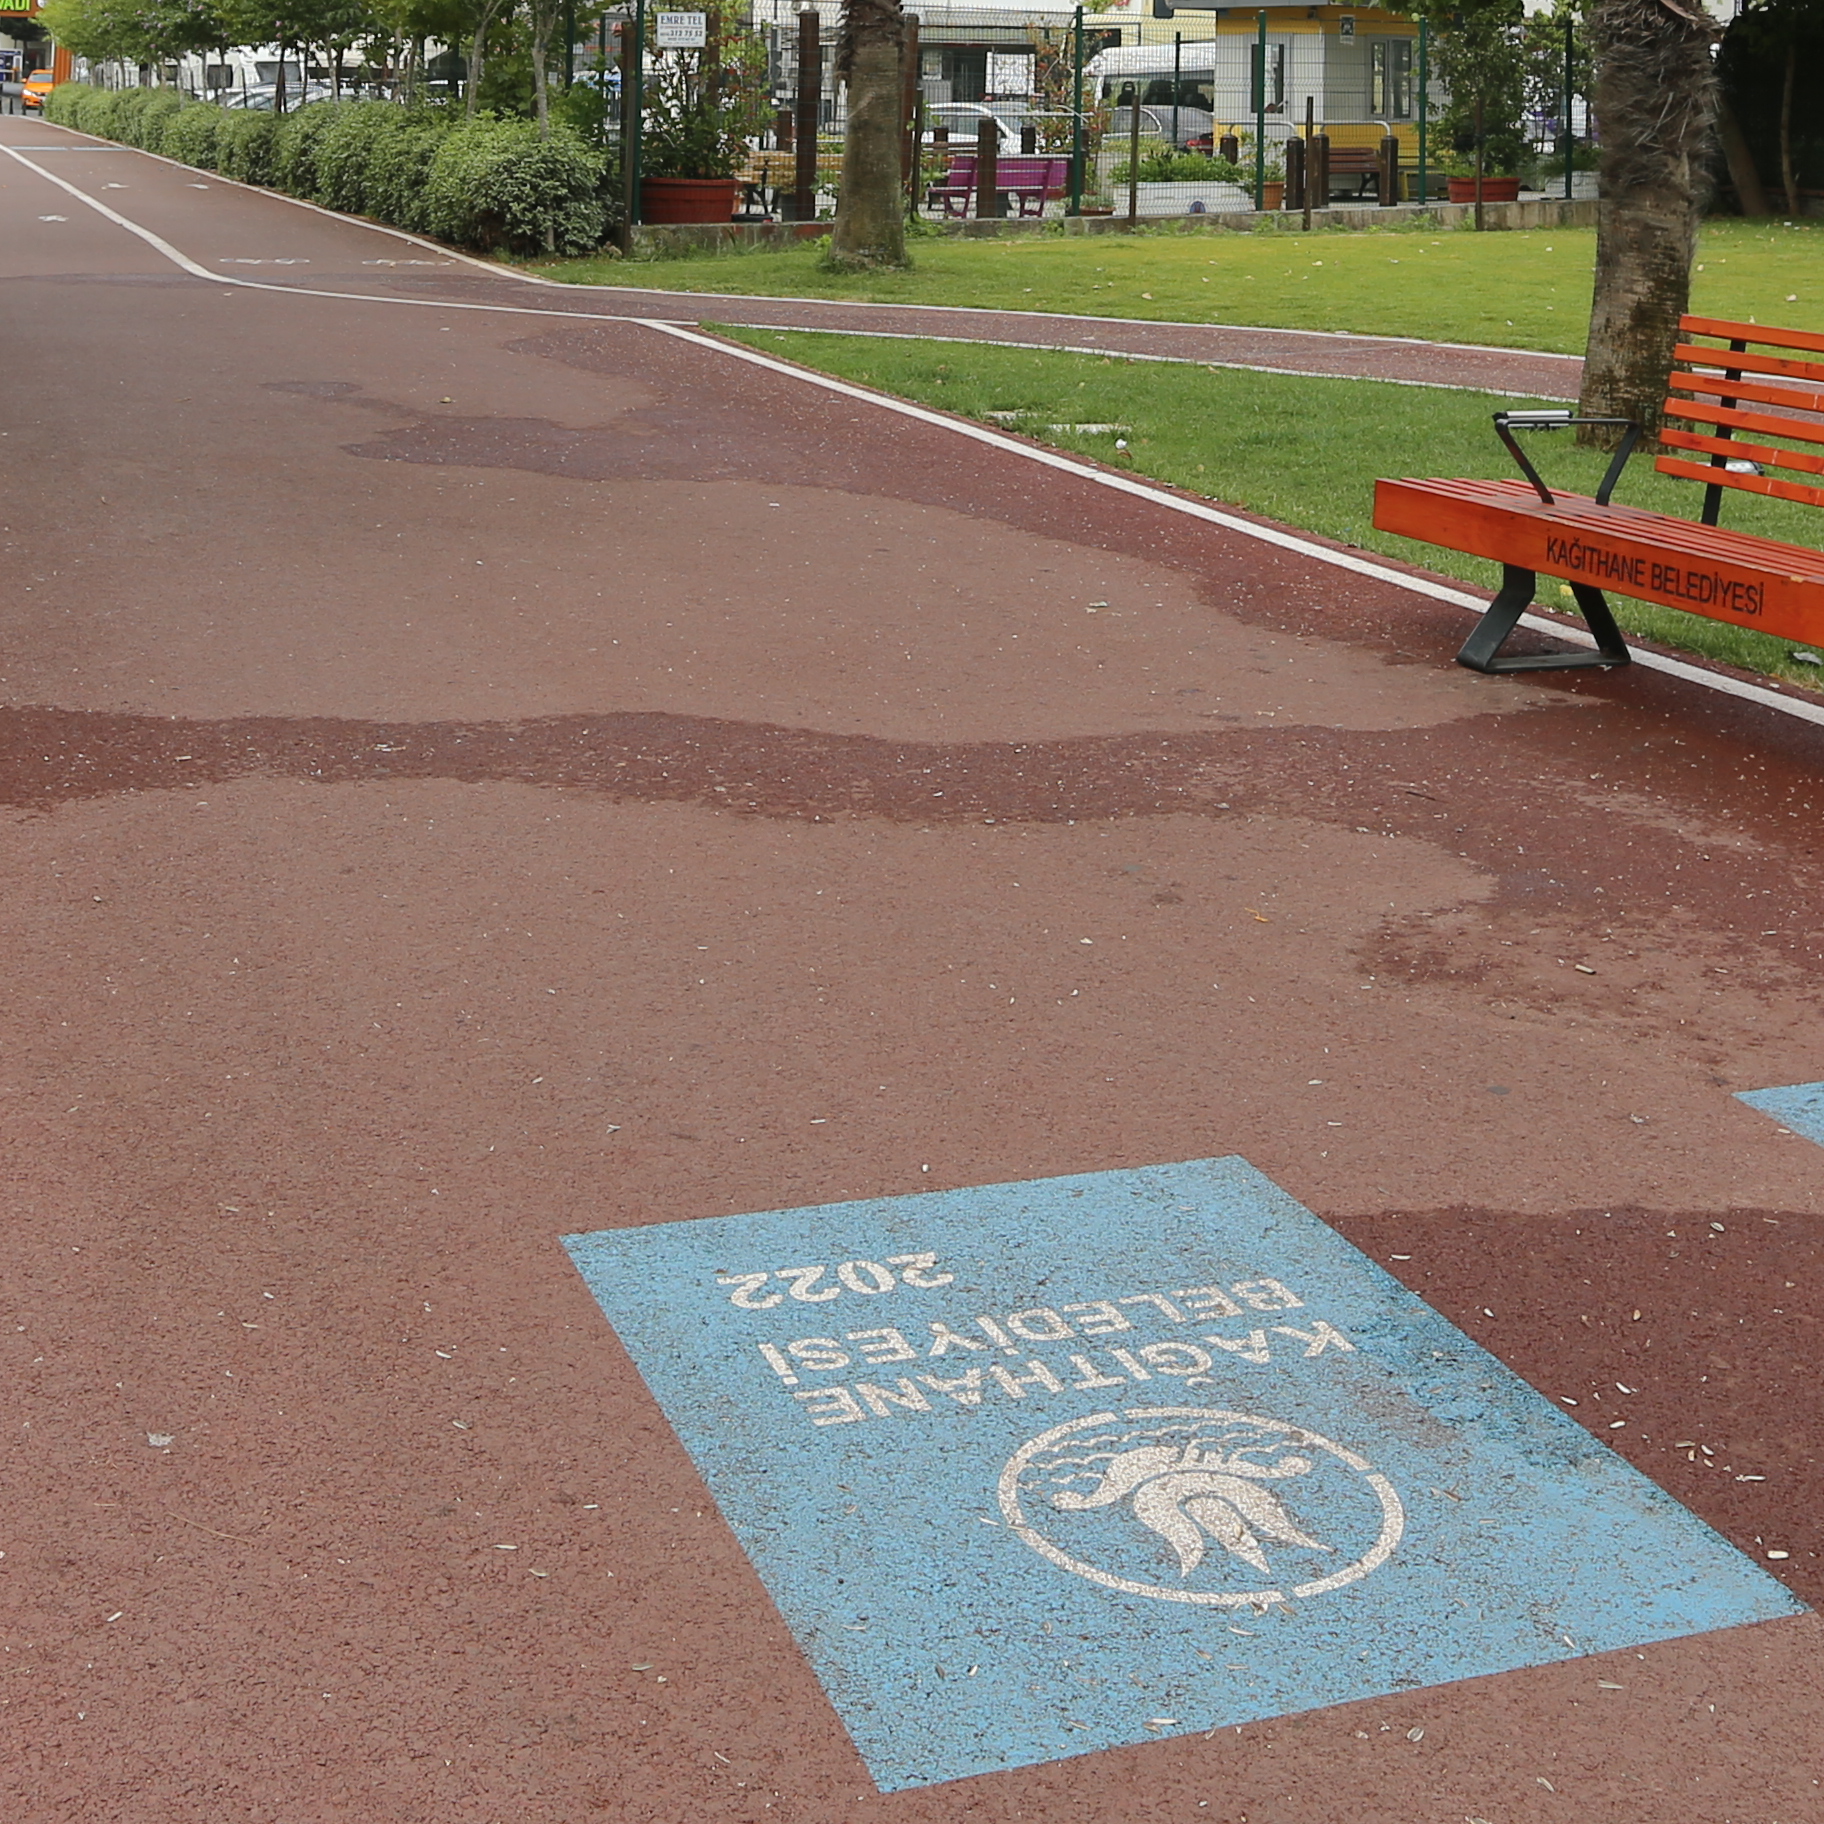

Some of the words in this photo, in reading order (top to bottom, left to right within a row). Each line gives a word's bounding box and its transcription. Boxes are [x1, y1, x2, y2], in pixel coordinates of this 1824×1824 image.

[660, 15, 684, 25] EMRE
[687, 15, 703, 25] TEL
[1546, 536, 1646, 587] KAĞITHANE
[1650, 562, 1765, 616] BELEDİYESİ
[714, 1250, 955, 1310] 2022
[756, 1276, 1306, 1385] BELEDİYESİ
[792, 1320, 1357, 1427] KAĞITHANE
